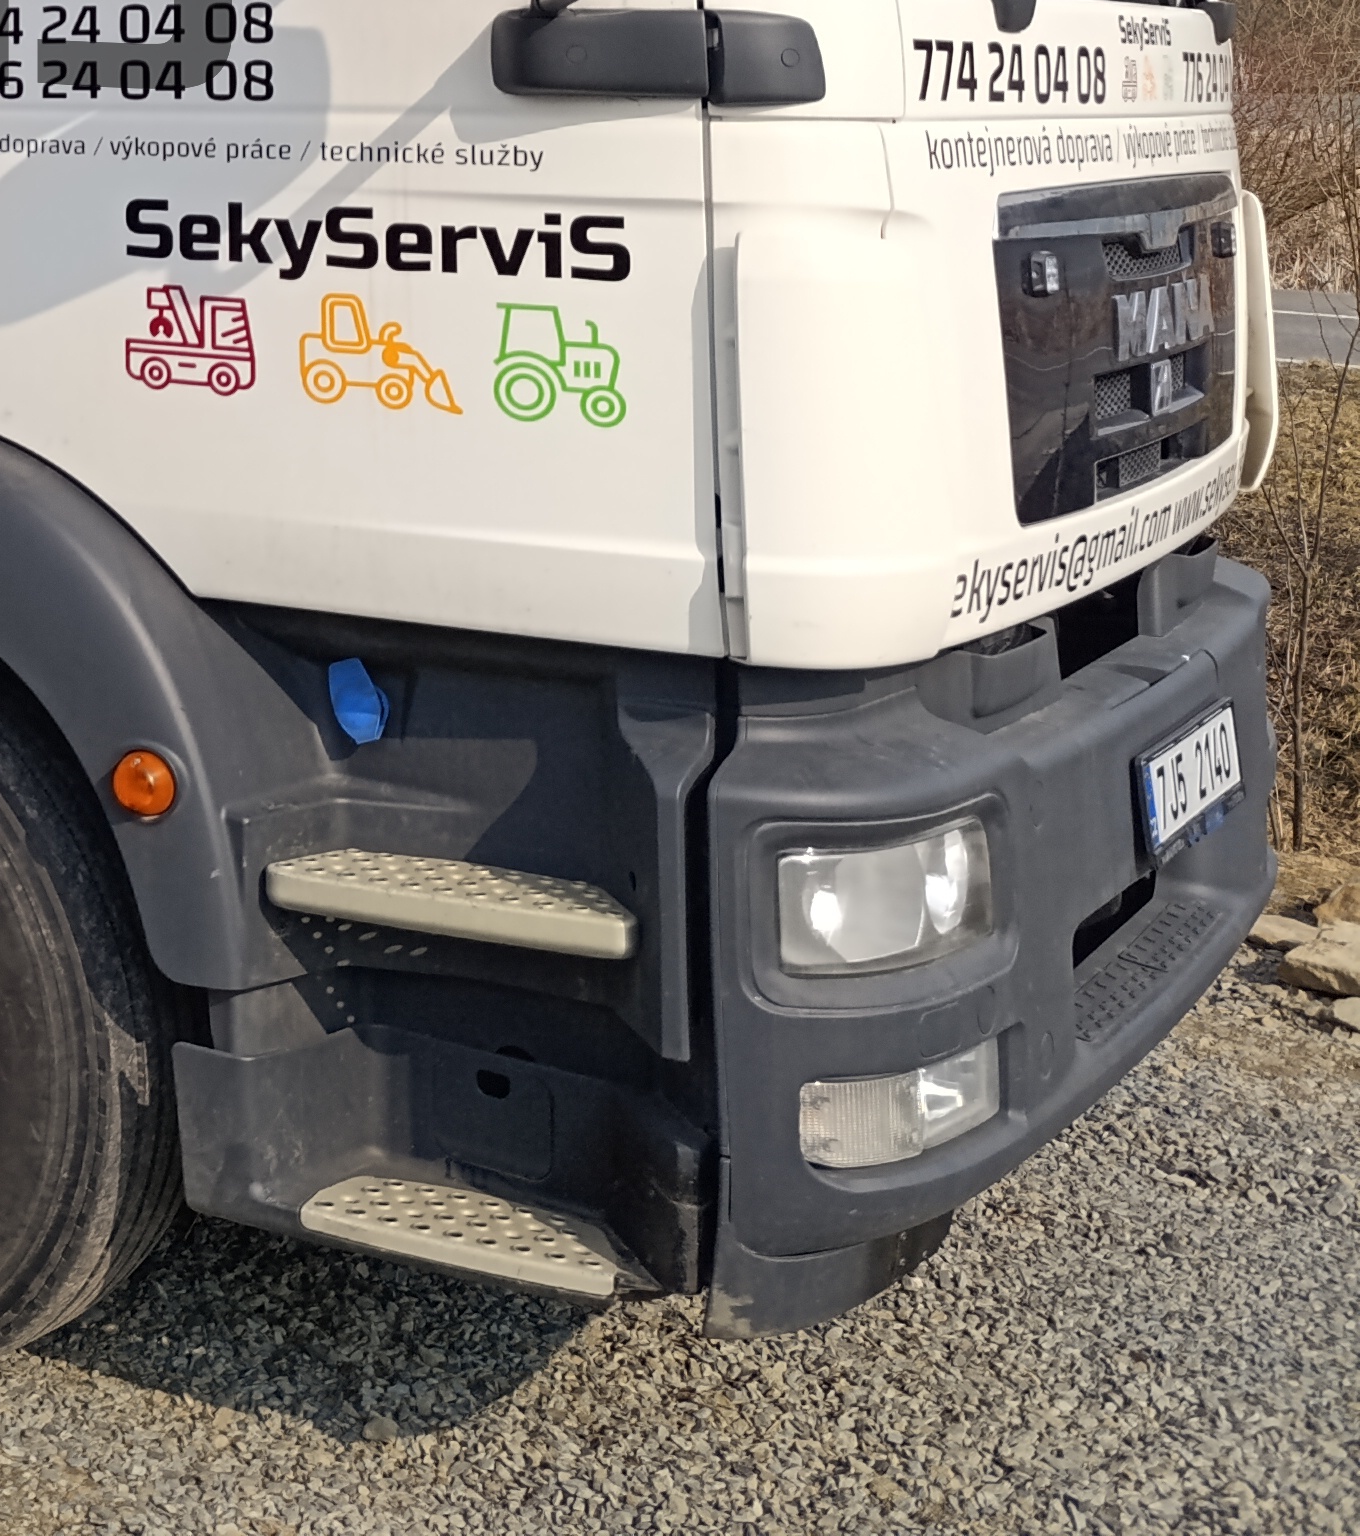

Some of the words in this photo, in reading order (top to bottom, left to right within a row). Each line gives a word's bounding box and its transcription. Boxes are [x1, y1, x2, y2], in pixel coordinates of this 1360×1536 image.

[41, 5, 101, 45] 24
[119, 4, 186, 44] 04
[204, 2, 275, 44] 08
[41, 60, 102, 100] 24
[119, 60, 187, 101] 04
[204, 59, 275, 102] 08
[913, 39, 978, 102] 774
[988, 41, 1025, 103] 24
[1034, 44, 1069, 104] 04
[1077, 45, 1106, 105] 08
[1182, 51, 1203, 103] 776
[1205, 52, 1218, 103] 24
[93, 137, 104, 156] /
[109, 135, 217, 162] výkopové
[225, 138, 292, 162] práce
[300, 140, 311, 162] /
[320, 140, 445, 164] technické
[455, 144, 544, 172] služby
[925, 125, 1052, 177] kontejnerová
[1056, 126, 1113, 172] doprava
[1123, 123, 1172, 168] výkopové
[125, 197, 631, 282] SekyServiS
[1112, 272, 1214, 362] MAN
[1156, 752, 1188, 830] 7J5
[1194, 722, 1231, 799] 2140
